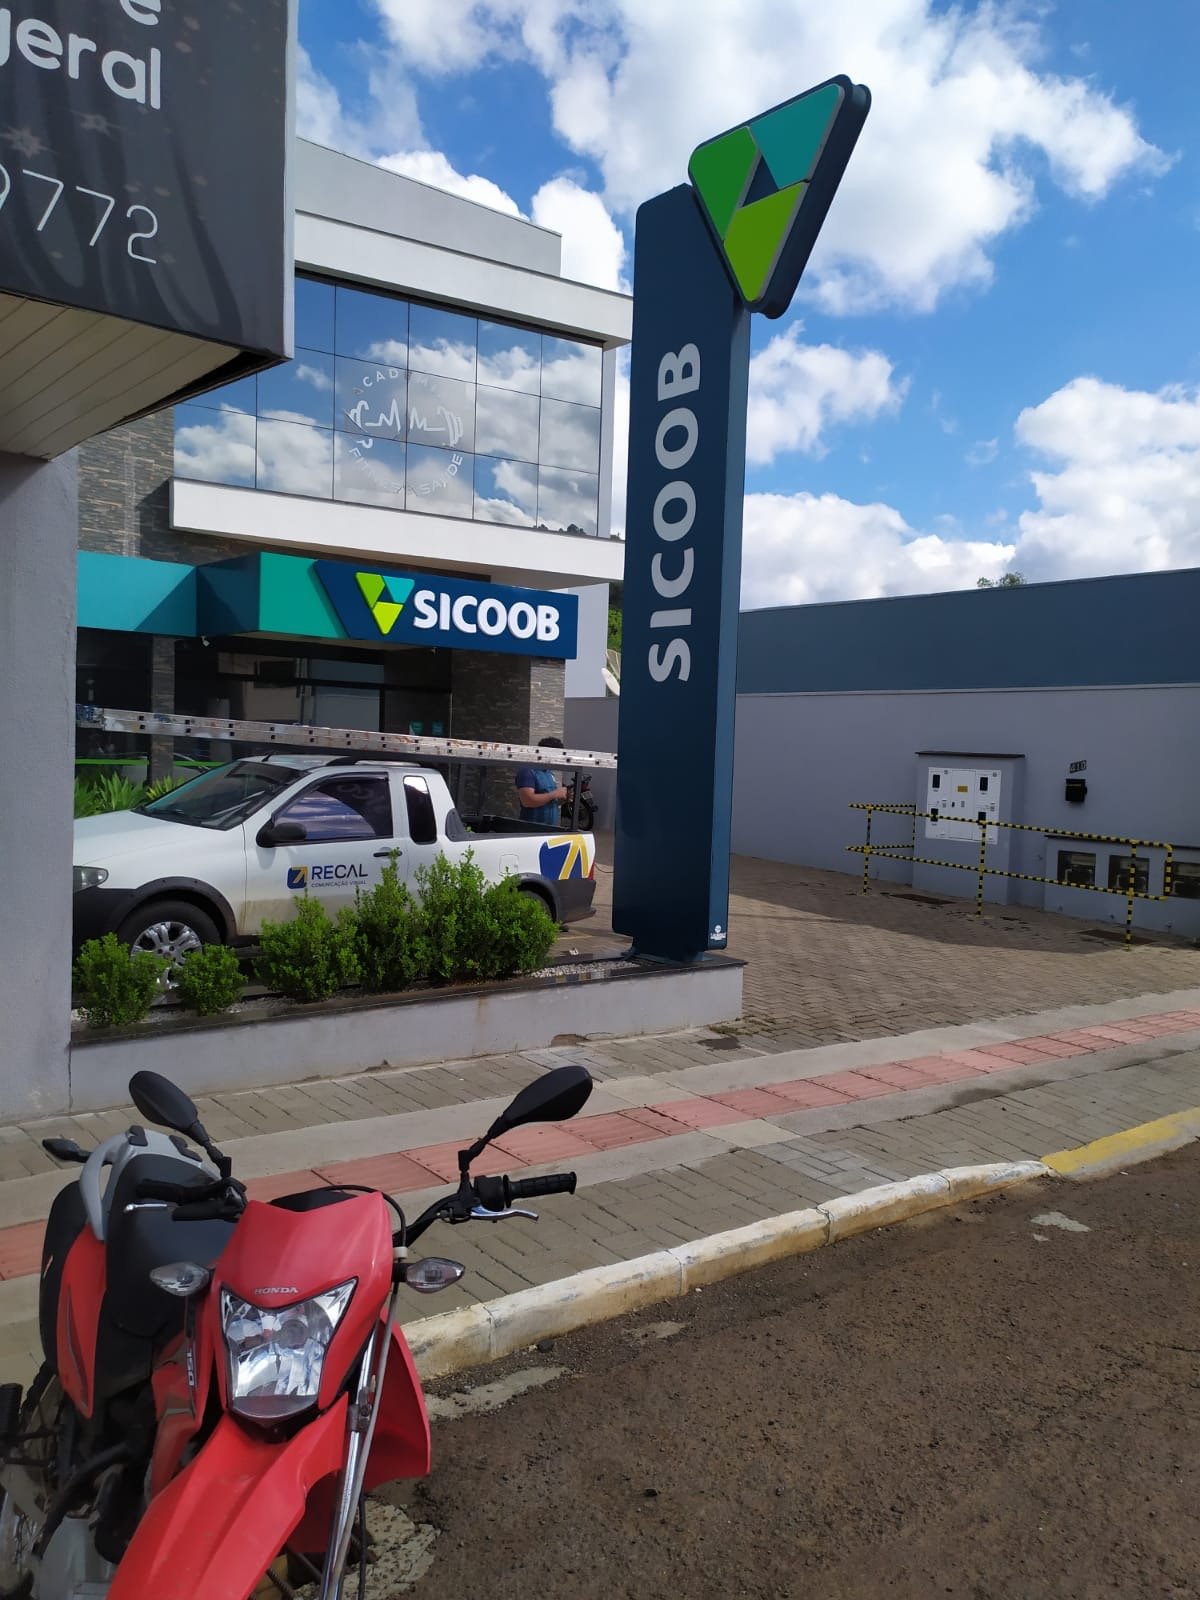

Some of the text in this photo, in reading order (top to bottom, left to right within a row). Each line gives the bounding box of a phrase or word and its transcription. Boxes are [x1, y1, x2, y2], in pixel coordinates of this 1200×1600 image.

[648, 342, 701, 683] SICOOB
[412, 589, 561, 642] SICOOB
[311, 864, 368, 880] RECAL
[255, 1286, 299, 1295] HONDA
